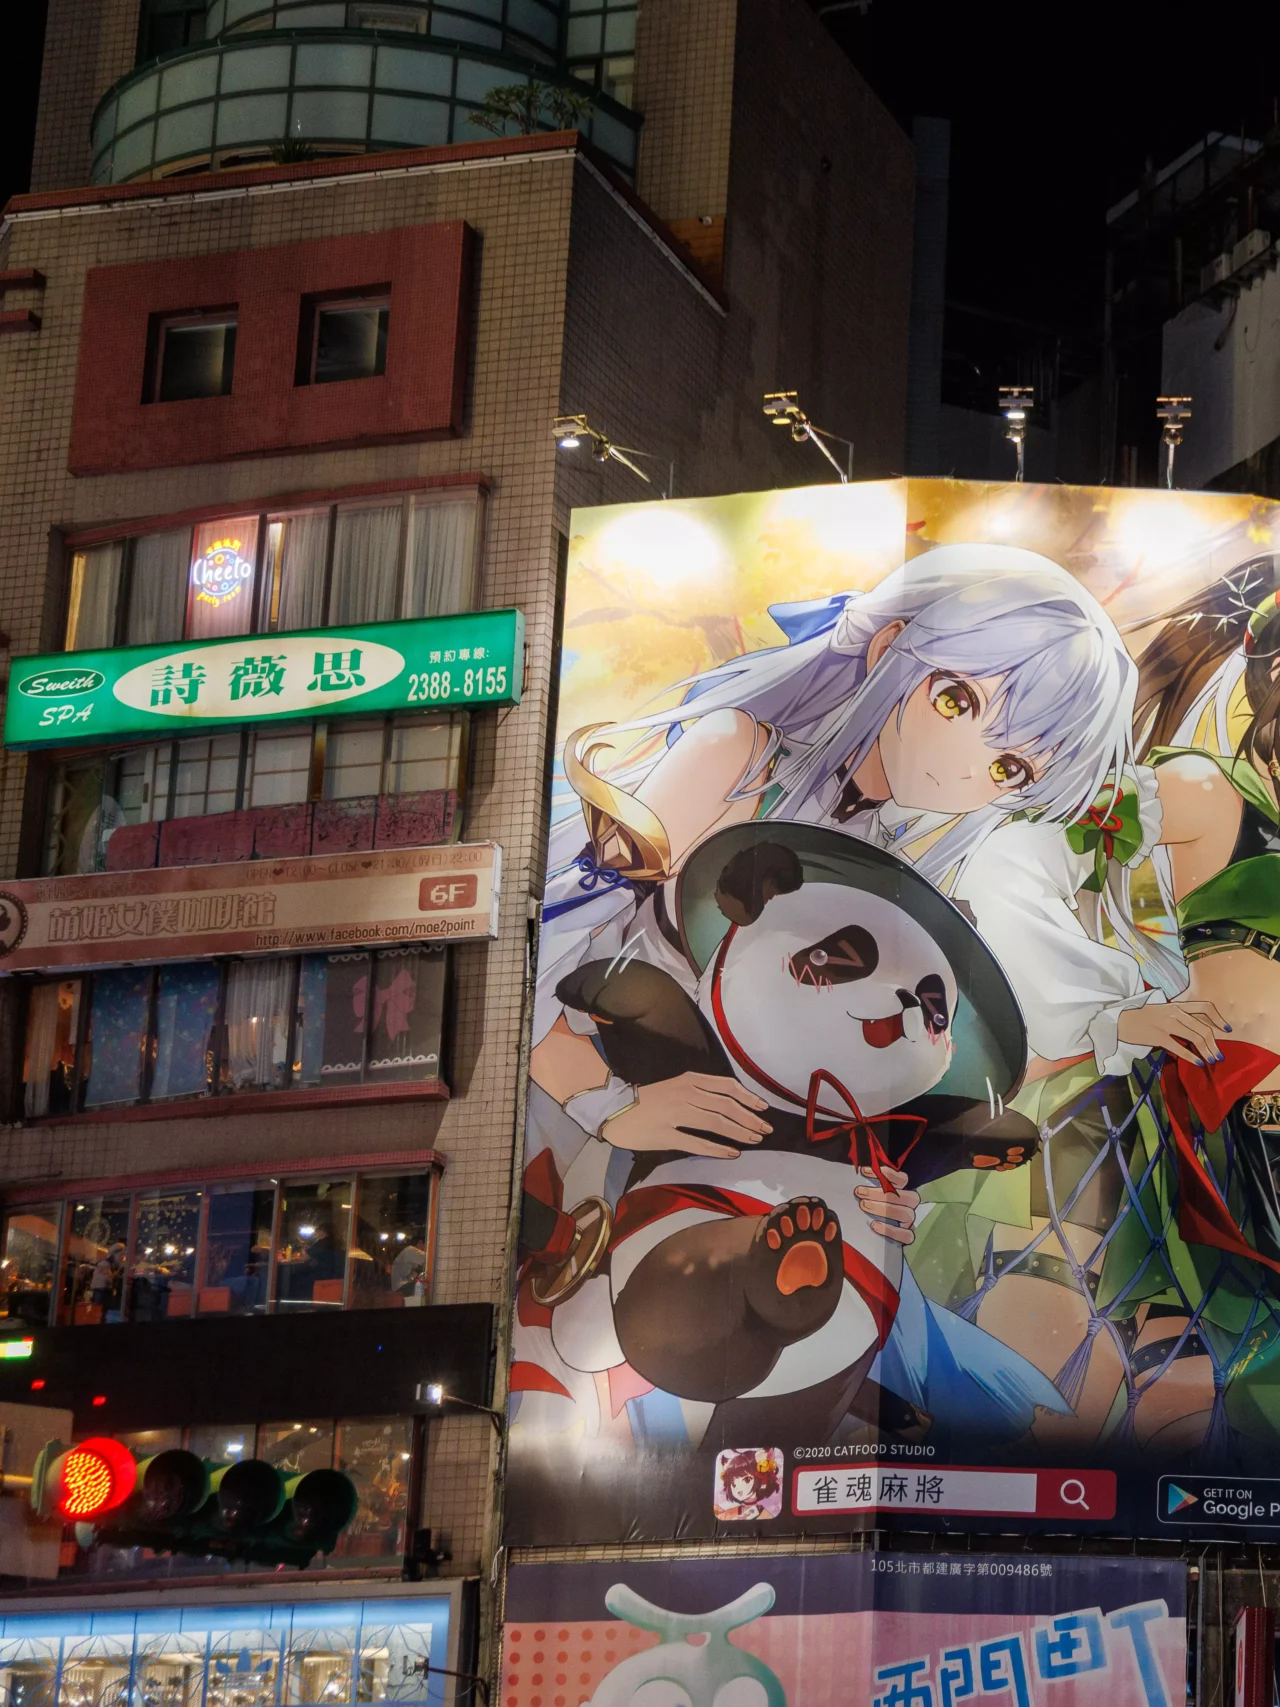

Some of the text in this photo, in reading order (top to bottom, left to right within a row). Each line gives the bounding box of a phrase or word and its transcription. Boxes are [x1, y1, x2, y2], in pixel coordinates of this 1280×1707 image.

[27, 673, 97, 695] Sweith
[149, 647, 366, 707] 詩薇思
[407, 666, 508, 702] 2388-8155
[38, 703, 95, 727] SPA
[430, 883, 467, 907] 6F
[48, 891, 276, 942] 萌姬女僕咖啡館
[255, 919, 476, 947] http://www.facebook.com/moe2point
[834, 1444, 887, 1457] CATFOOD
[890, 1444, 936, 1457] STUDIO
[812, 1473, 944, 1505] 雀魂麻將
[1203, 1488, 1252, 1500] GET IT ON
[1203, 1500, 1266, 1521] Google
[870, 1558, 1053, 1578] 105北市都建廣字第009486號
